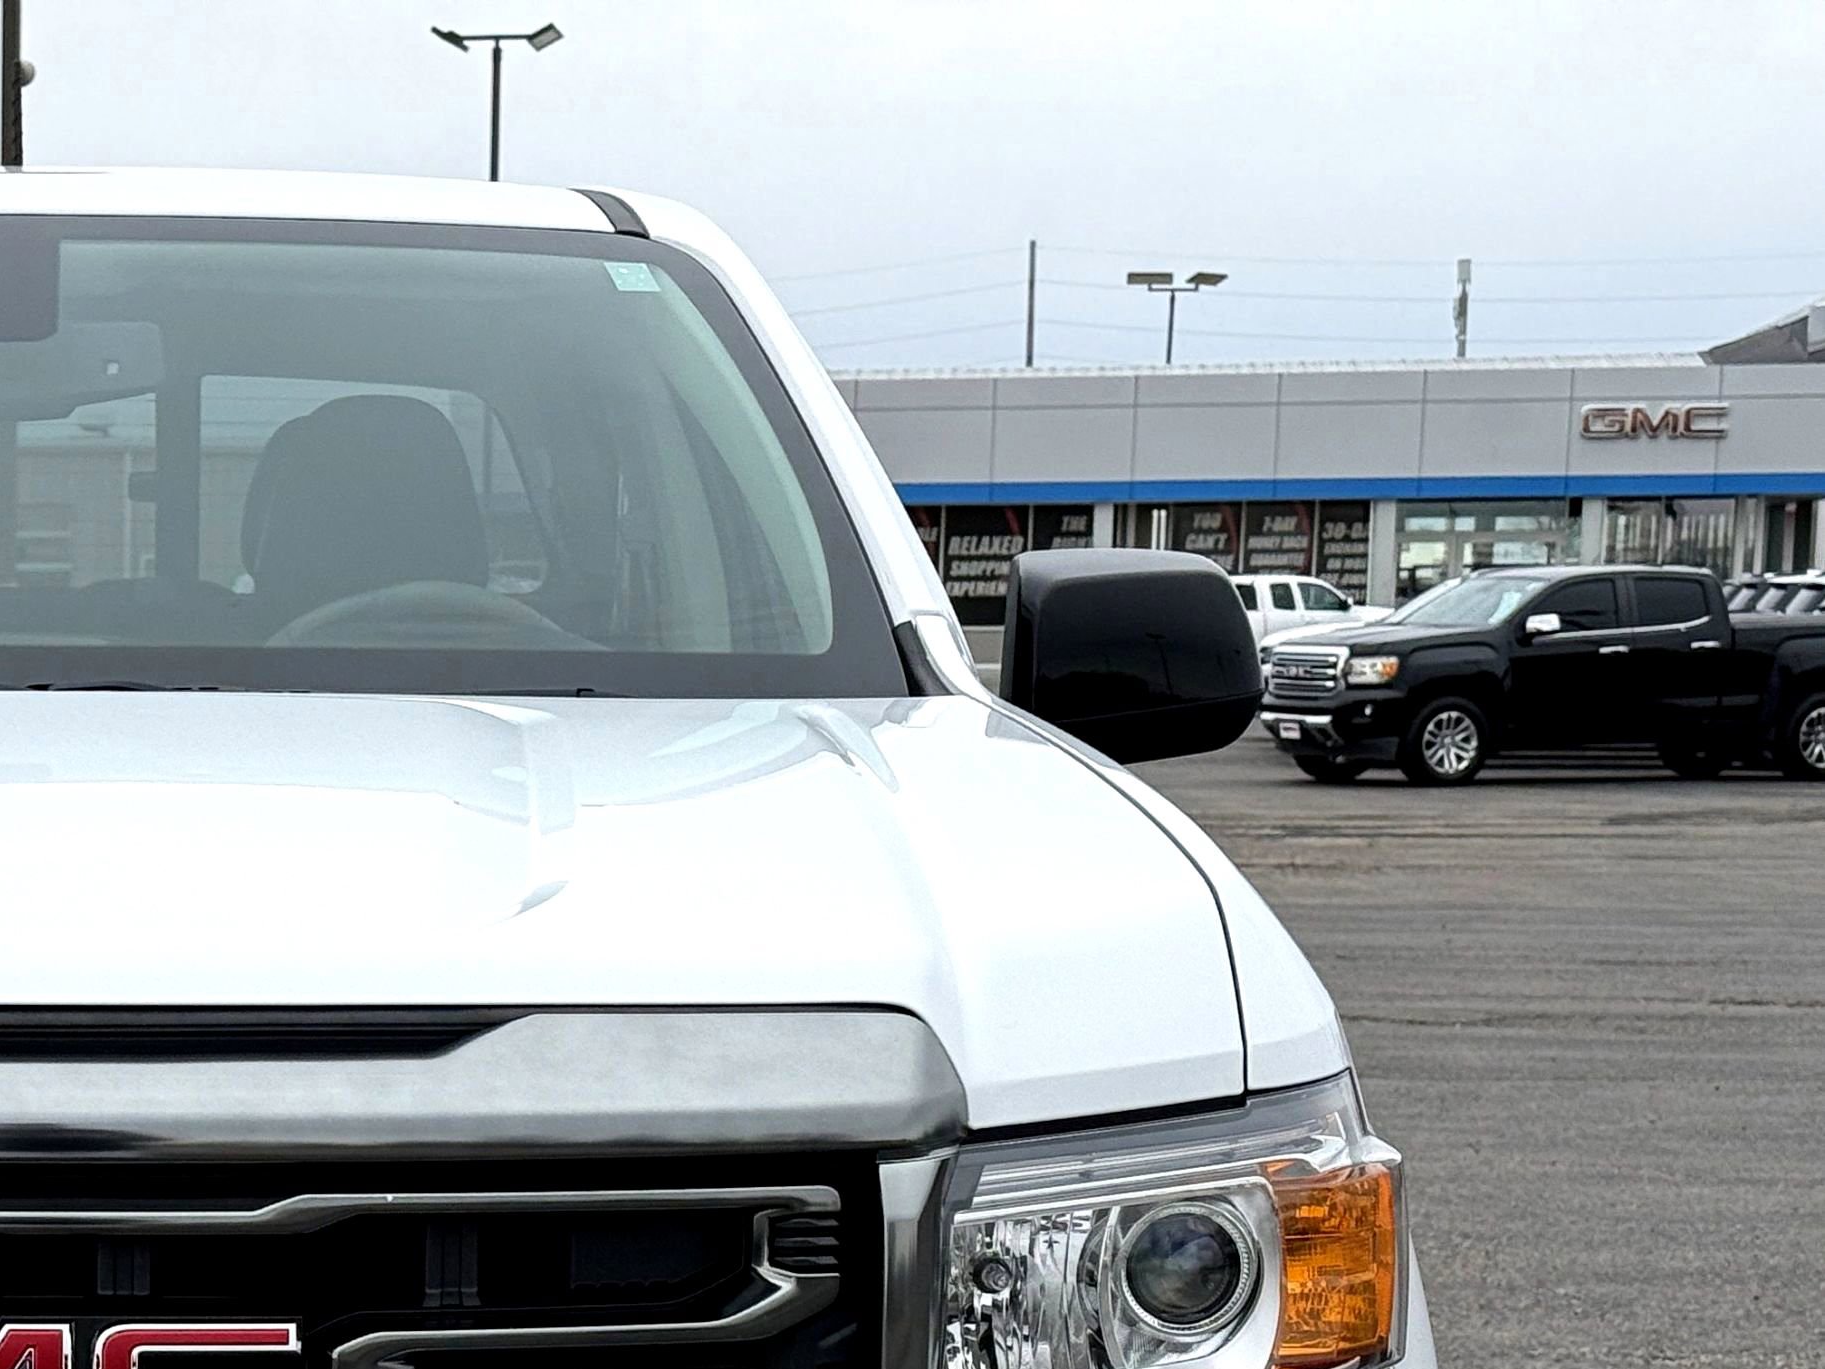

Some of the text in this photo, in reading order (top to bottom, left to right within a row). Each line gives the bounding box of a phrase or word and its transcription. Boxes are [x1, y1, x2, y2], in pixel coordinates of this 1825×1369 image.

[1581, 403, 1730, 439] GMC
[948, 535, 1024, 556] RELAXED
[949, 560, 1011, 577] SHOPPIN
[945, 581, 1009, 597] EXPERIEN
